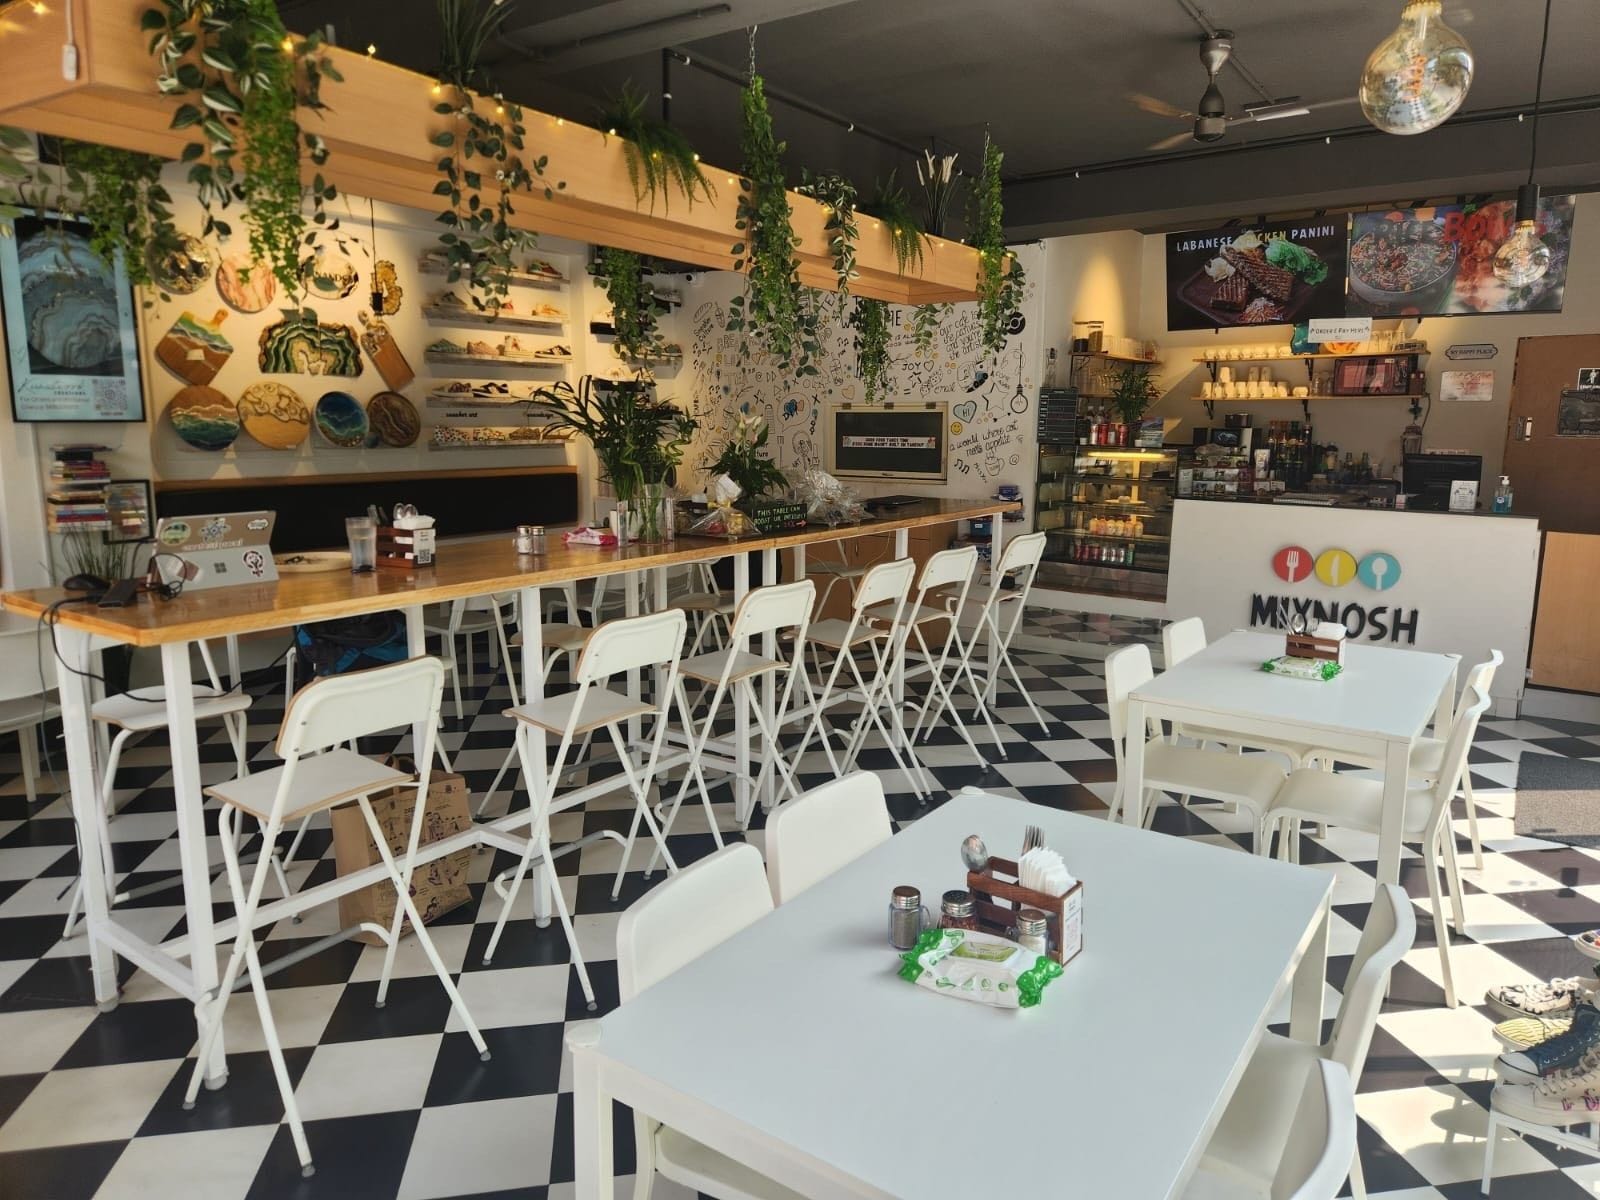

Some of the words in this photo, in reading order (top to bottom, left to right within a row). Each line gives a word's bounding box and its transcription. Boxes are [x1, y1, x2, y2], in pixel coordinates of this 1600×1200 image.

[1176, 236, 1233, 252] LABANESE
[1291, 225, 1335, 240] PANINI
[902, 361, 922, 372] JOY
[962, 408, 970, 417] HI
[757, 509, 771, 517] THIS
[773, 507, 788, 515] TABLE
